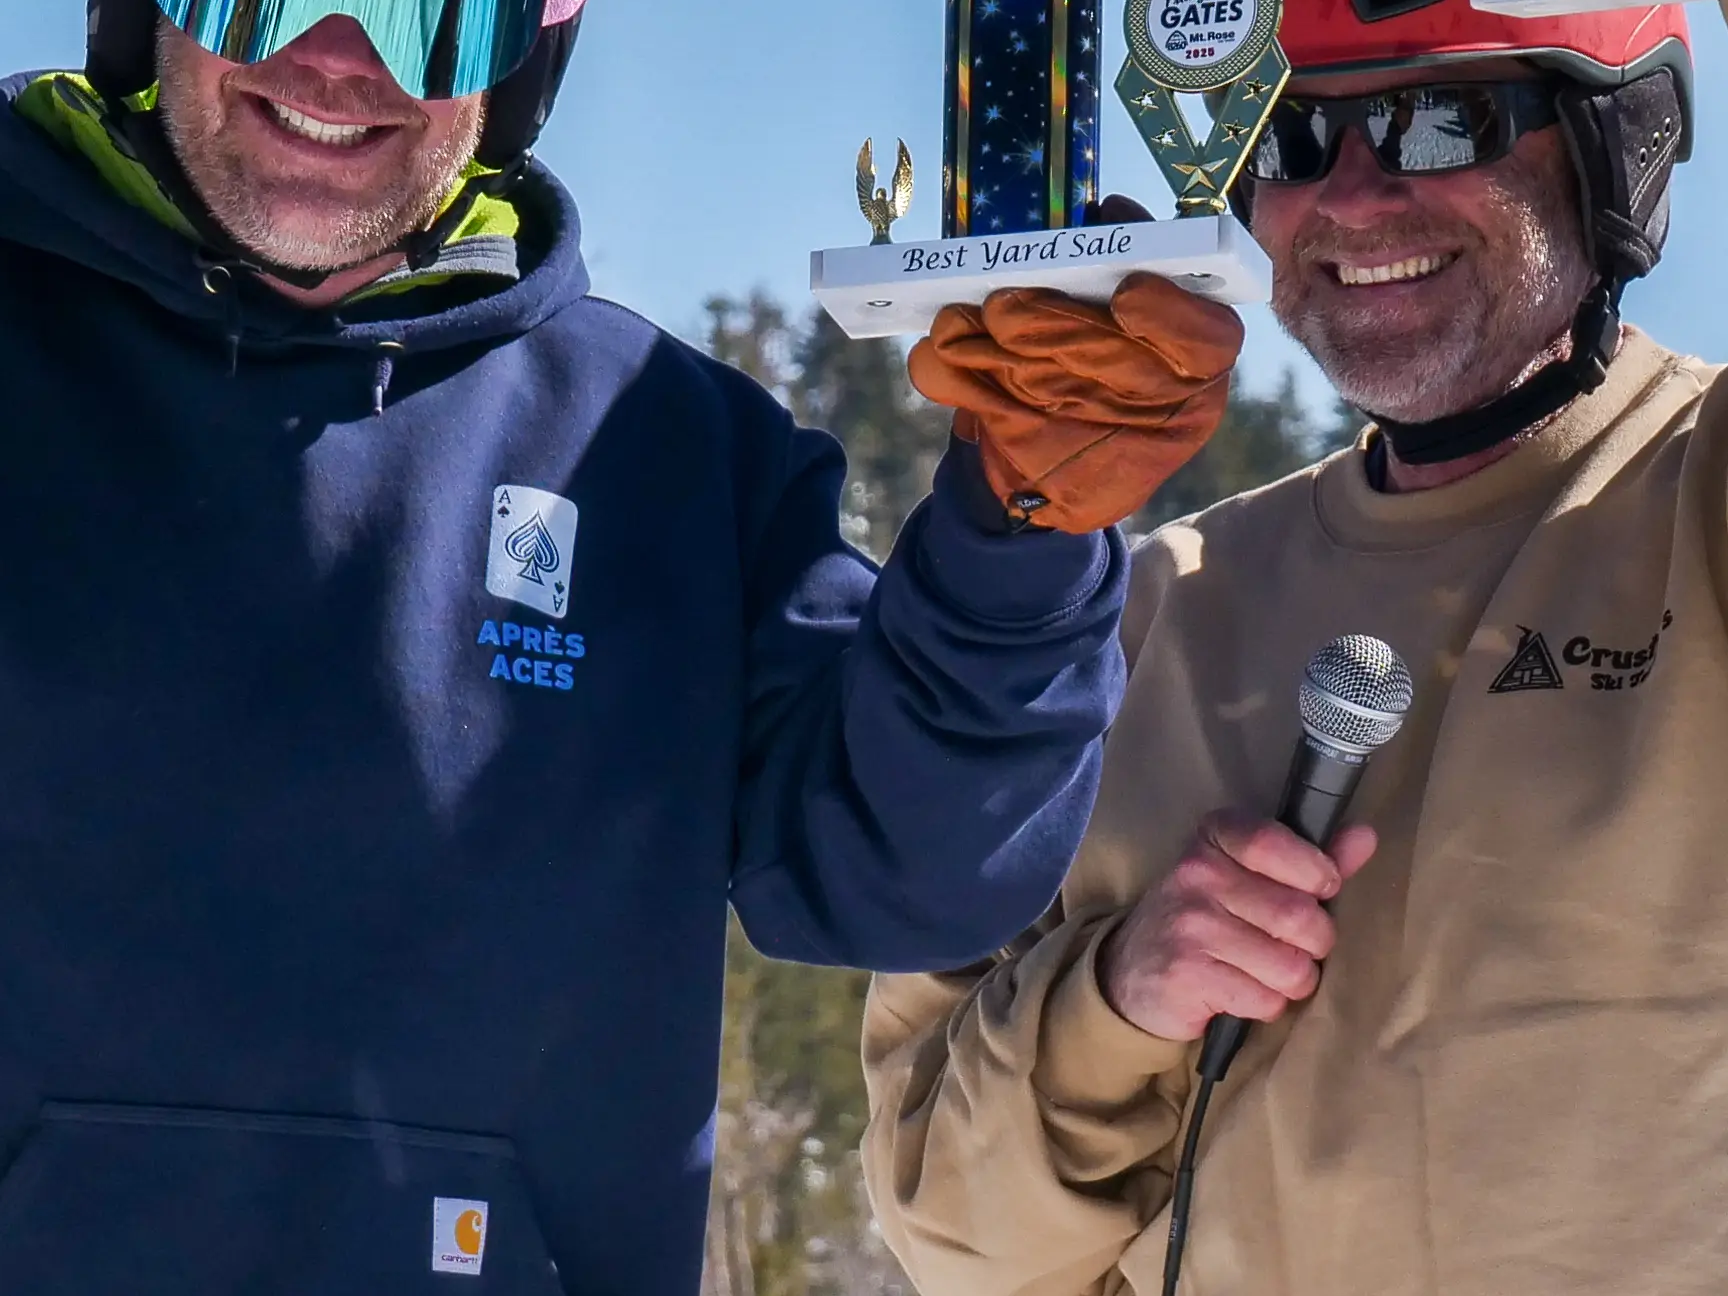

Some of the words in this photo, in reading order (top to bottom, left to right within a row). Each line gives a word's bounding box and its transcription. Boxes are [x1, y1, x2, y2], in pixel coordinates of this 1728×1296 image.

[1189, 33, 1207, 43] Mt.
[1207, 31, 1236, 41] Rose
[1185, 47, 1215, 60] 2025
[902, 244, 969, 272] Best
[980, 231, 1067, 271] Yard
[1068, 226, 1132, 258] Sale
[498, 488, 511, 504] A
[552, 594, 564, 613] A
[477, 619, 586, 658] APRÈS
[489, 654, 575, 690] ACES
